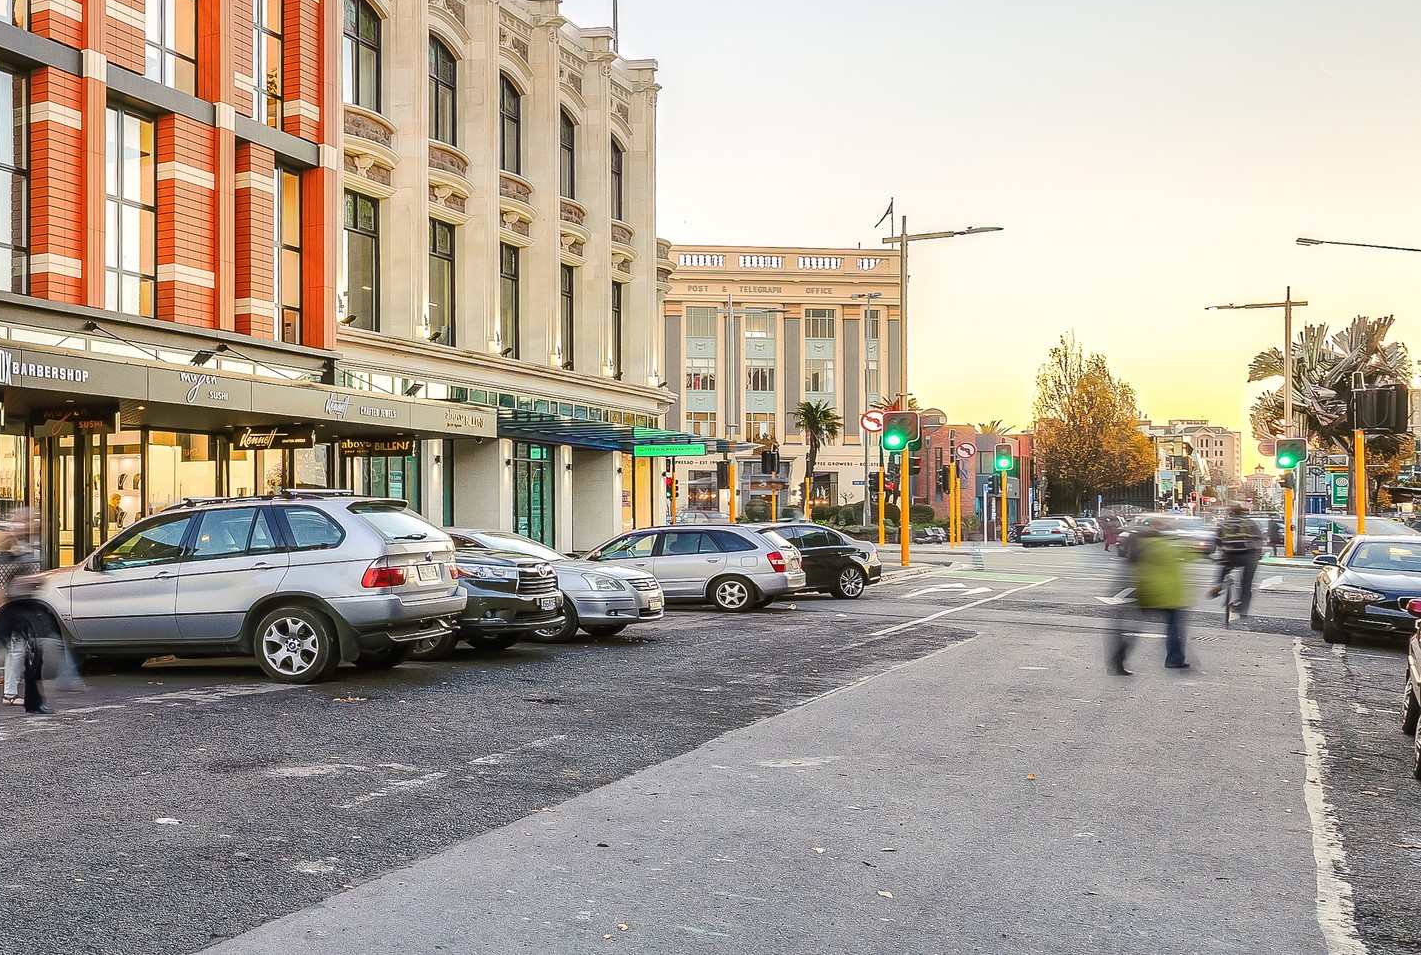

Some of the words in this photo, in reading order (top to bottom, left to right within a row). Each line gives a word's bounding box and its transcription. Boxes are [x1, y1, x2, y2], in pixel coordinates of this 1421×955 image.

[739, 286, 782, 294] TELEGRAPH
[12, 361, 89, 383] BARBERSHOP
[209, 390, 229, 401] SUSHI
[79, 420, 103, 429] SUSHI
[341, 439, 372, 449] above
[374, 441, 410, 451] BILLENS
